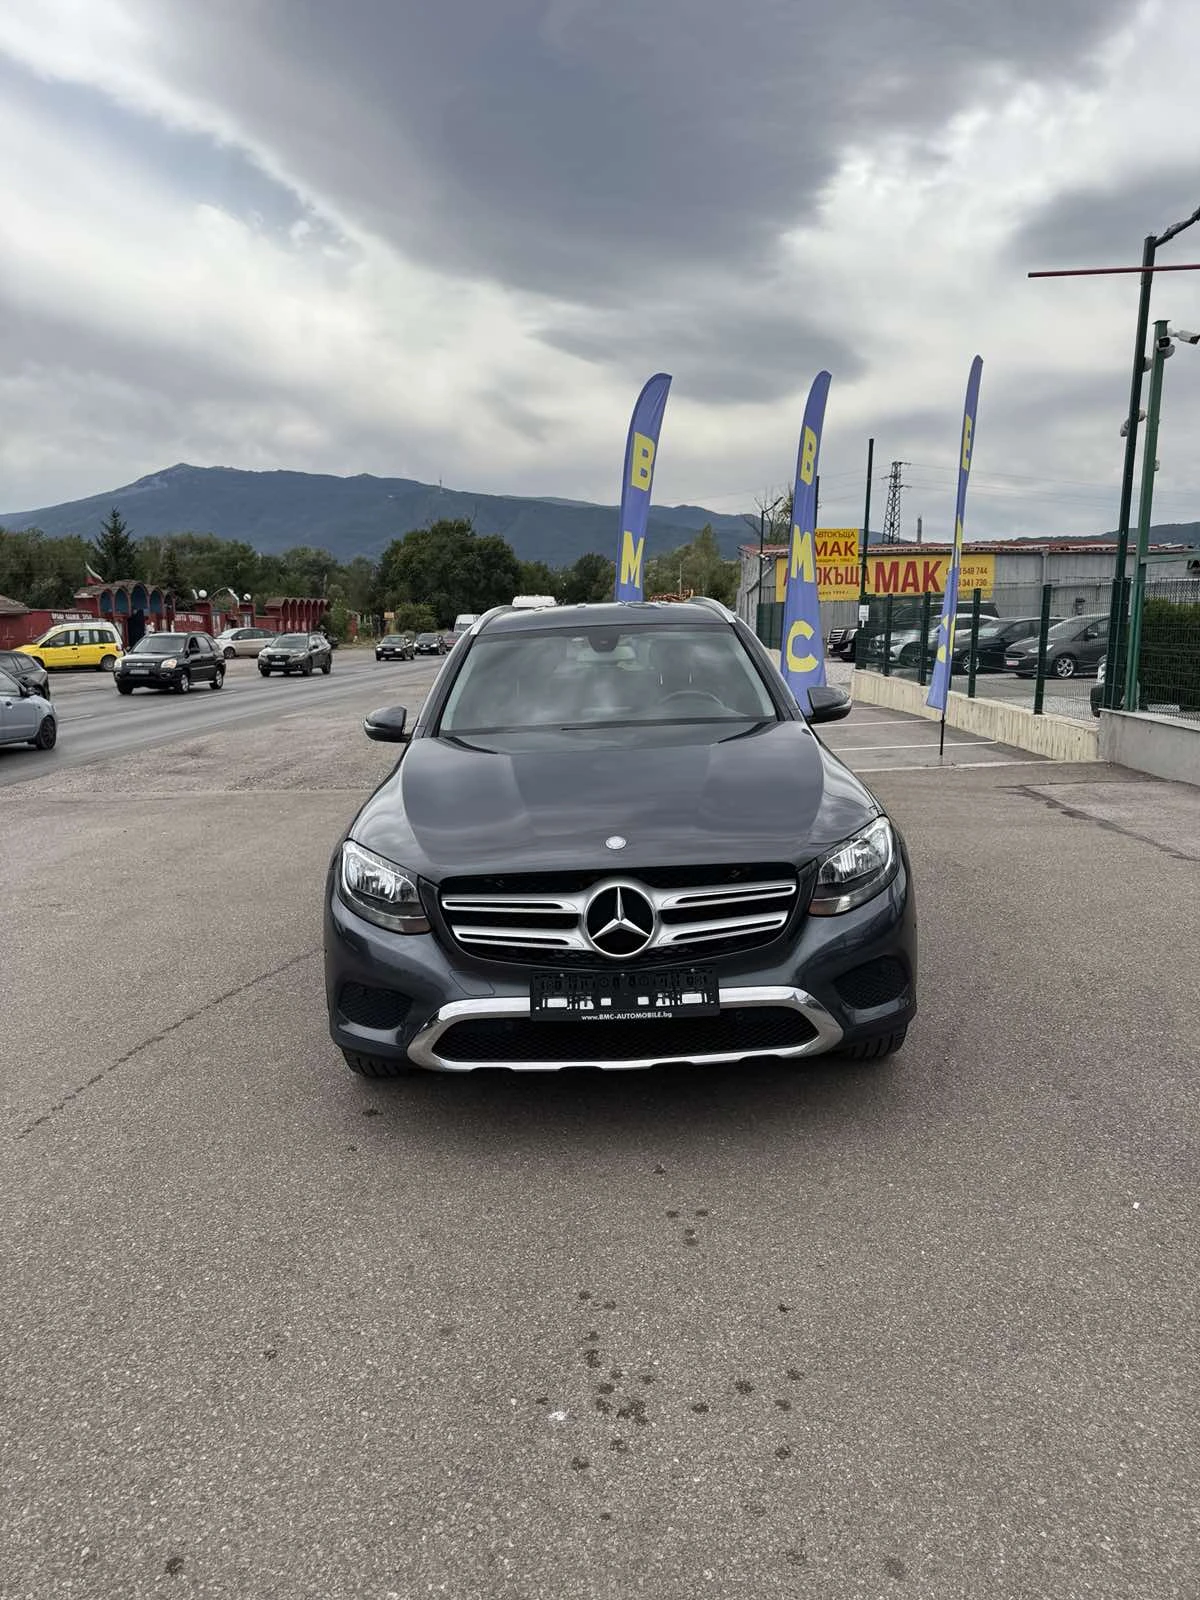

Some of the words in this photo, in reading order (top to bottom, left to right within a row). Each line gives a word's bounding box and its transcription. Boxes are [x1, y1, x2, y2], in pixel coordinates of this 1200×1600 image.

[815, 530, 856, 538] АВТОКЪЩА
[786, 425, 819, 673] BMC
[815, 540, 856, 557] МАК
[874, 560, 942, 593] МАК
[581, 1011, 673, 1021] www.BMC-AUTOMOBILE.bg
